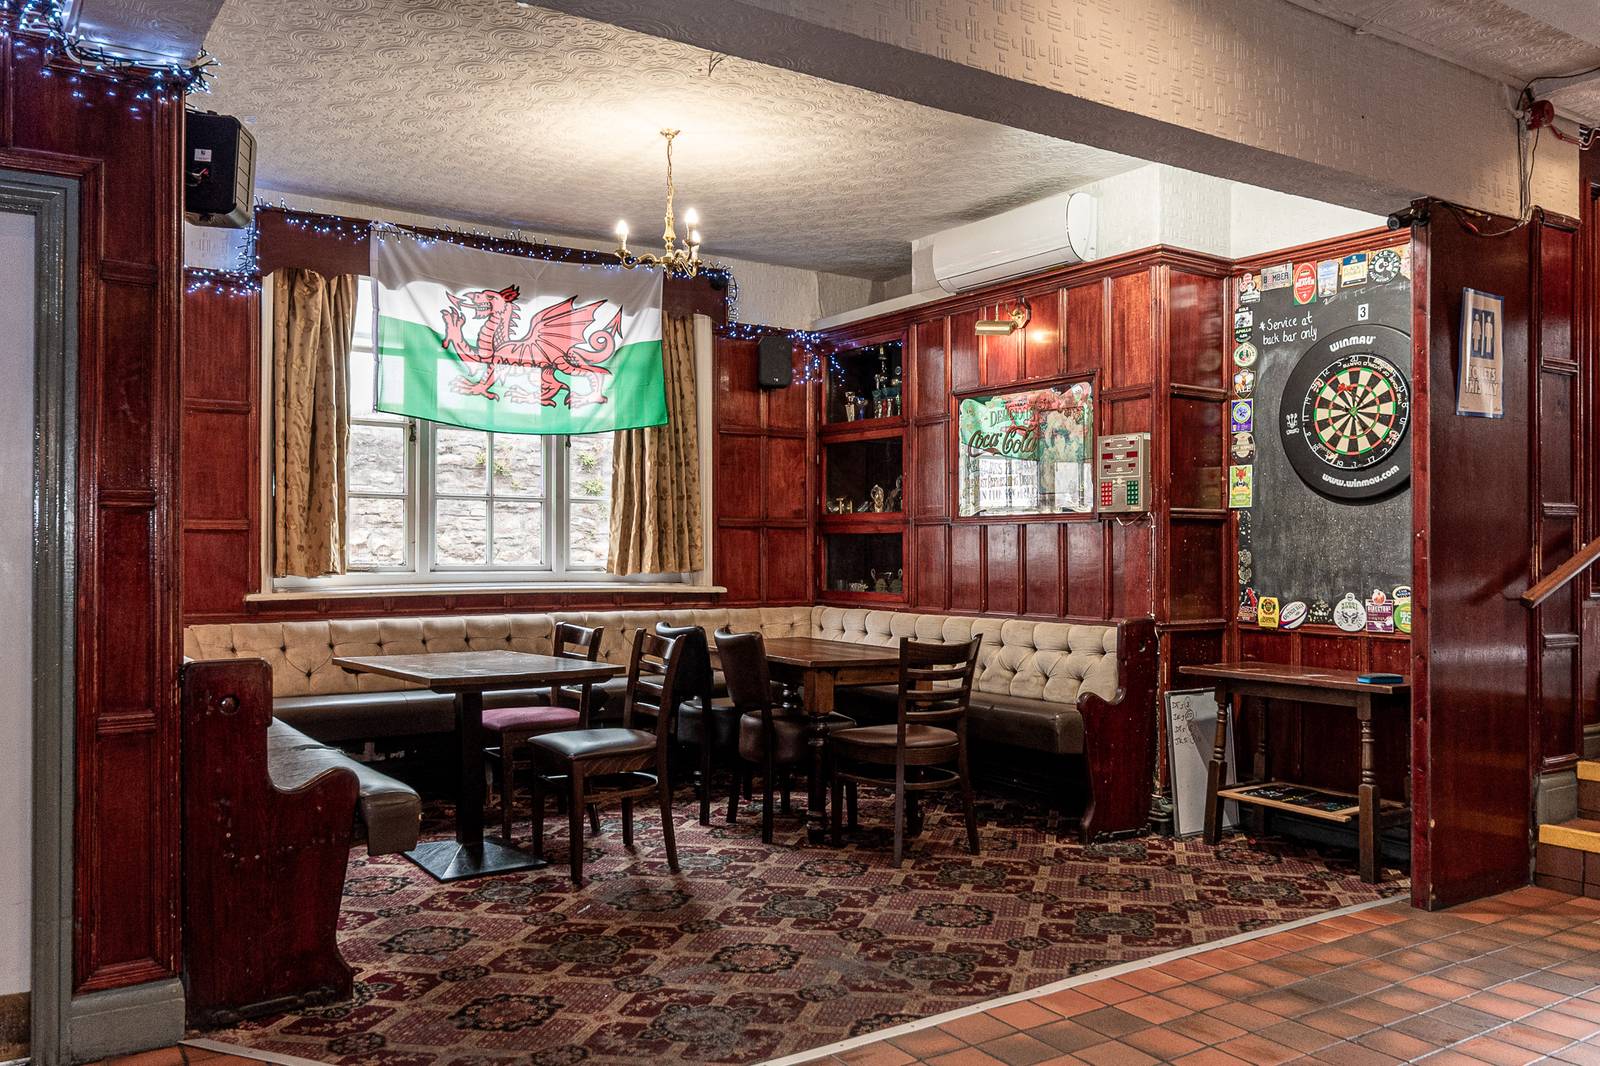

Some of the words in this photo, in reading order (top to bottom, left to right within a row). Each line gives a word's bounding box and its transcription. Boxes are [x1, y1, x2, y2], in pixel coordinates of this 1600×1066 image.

[1301, 310, 1313, 326] at
[1360, 307, 1367, 318] 3
[1263, 332, 1280, 345] back
[1282, 330, 1297, 343] bar
[1300, 325, 1318, 341] only
[1466, 365, 1497, 381] TOETS
[1322, 465, 1400, 488] www.winmau.com
